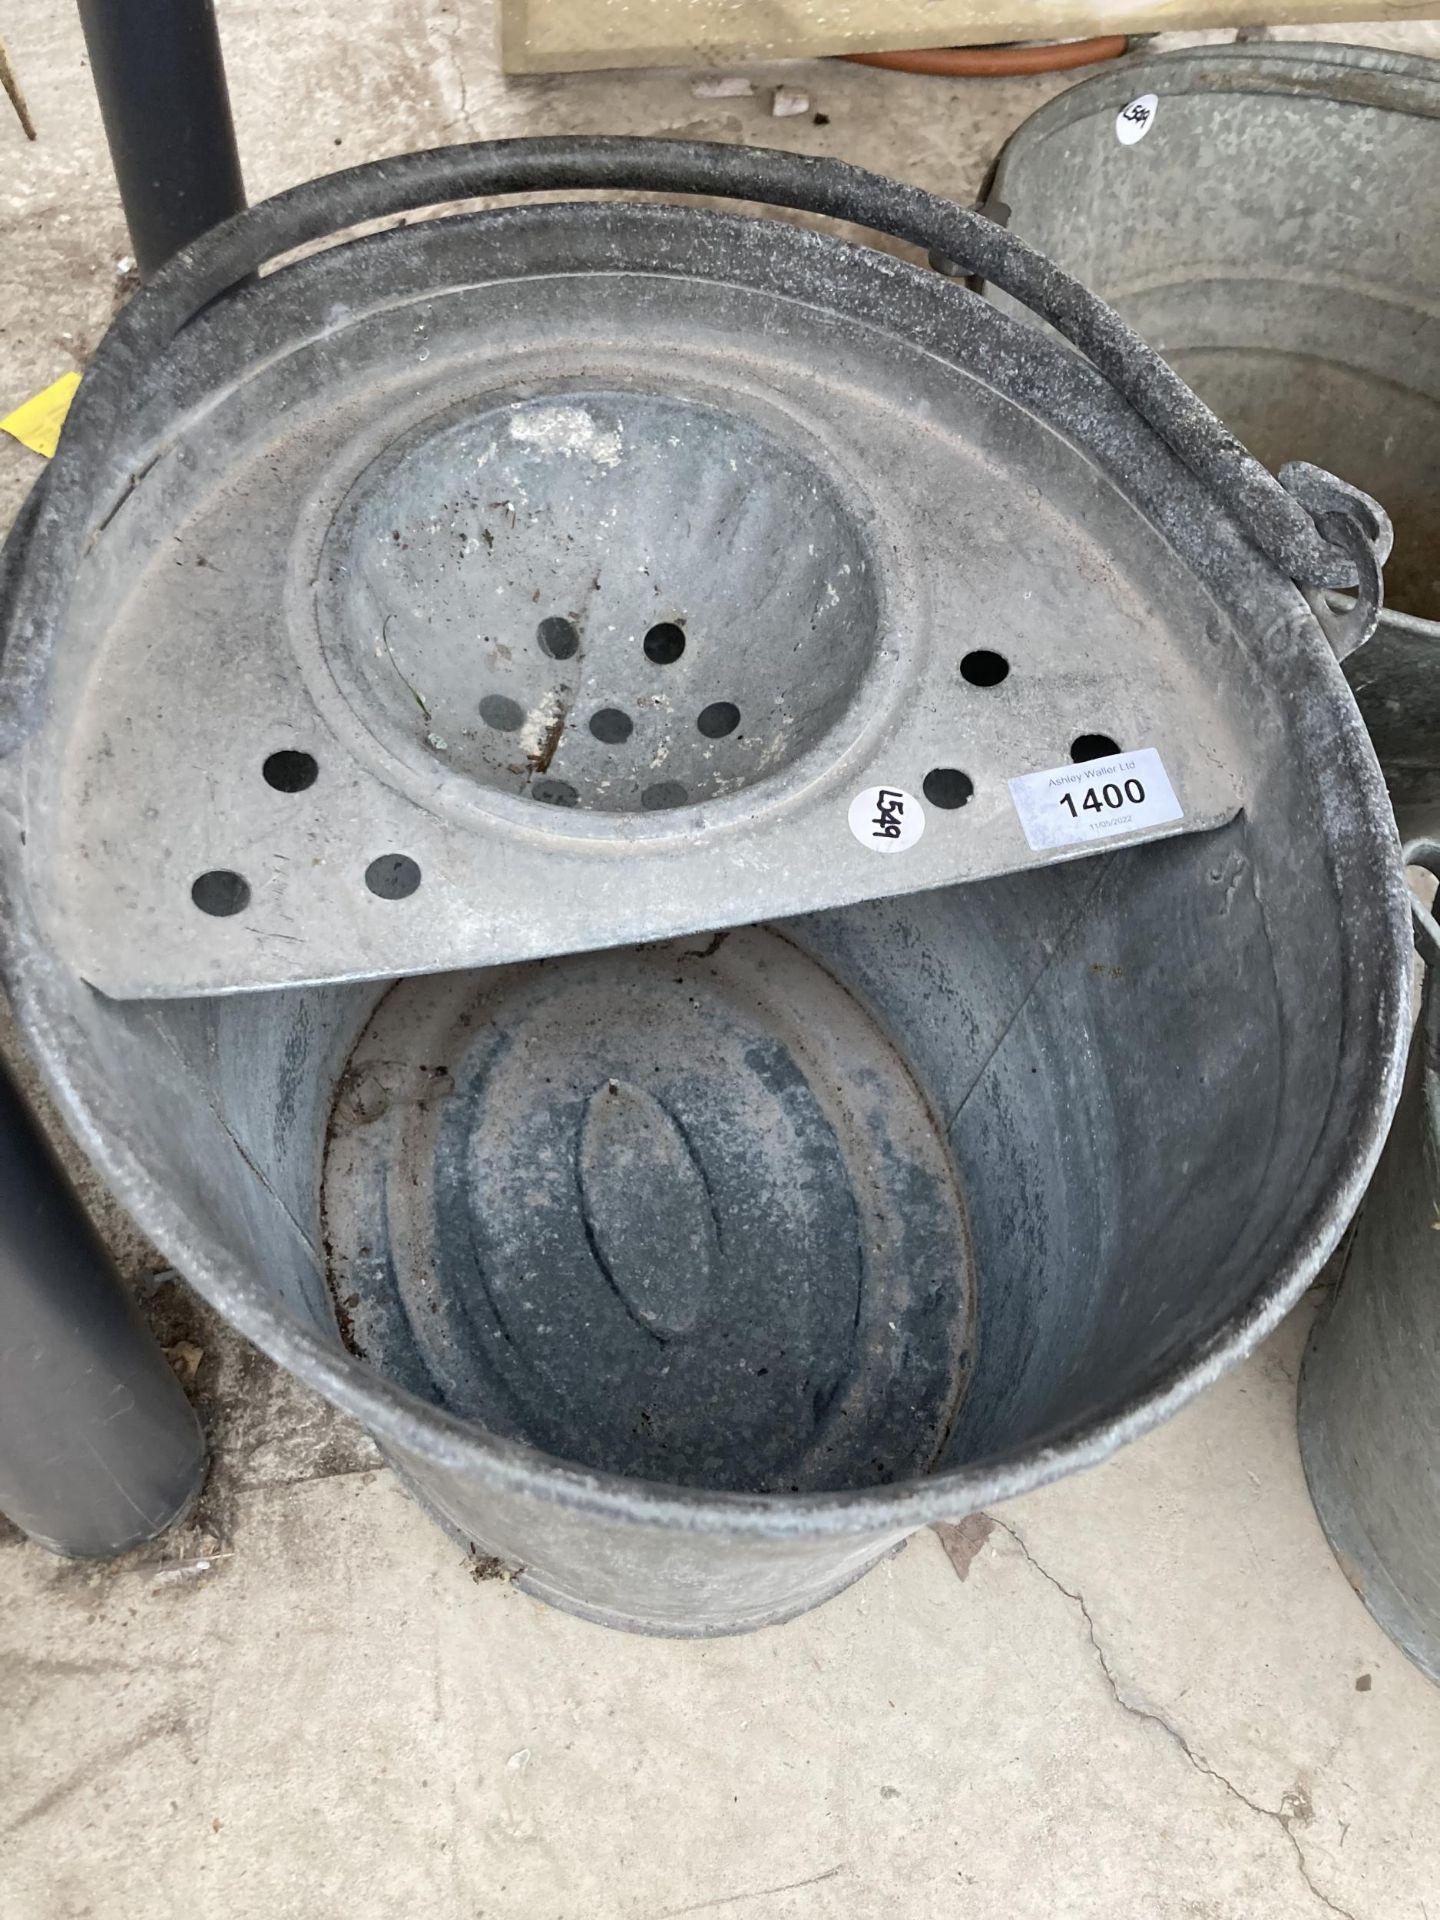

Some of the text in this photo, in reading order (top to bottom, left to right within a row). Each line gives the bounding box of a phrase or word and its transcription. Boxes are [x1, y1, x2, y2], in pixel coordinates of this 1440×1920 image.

[1048, 760, 1136, 787] Ashley Waller Ltd
[871, 789, 904, 839] L549
[1059, 778, 1146, 818] 1400
[1089, 815, 1133, 831] 11/05/2022
